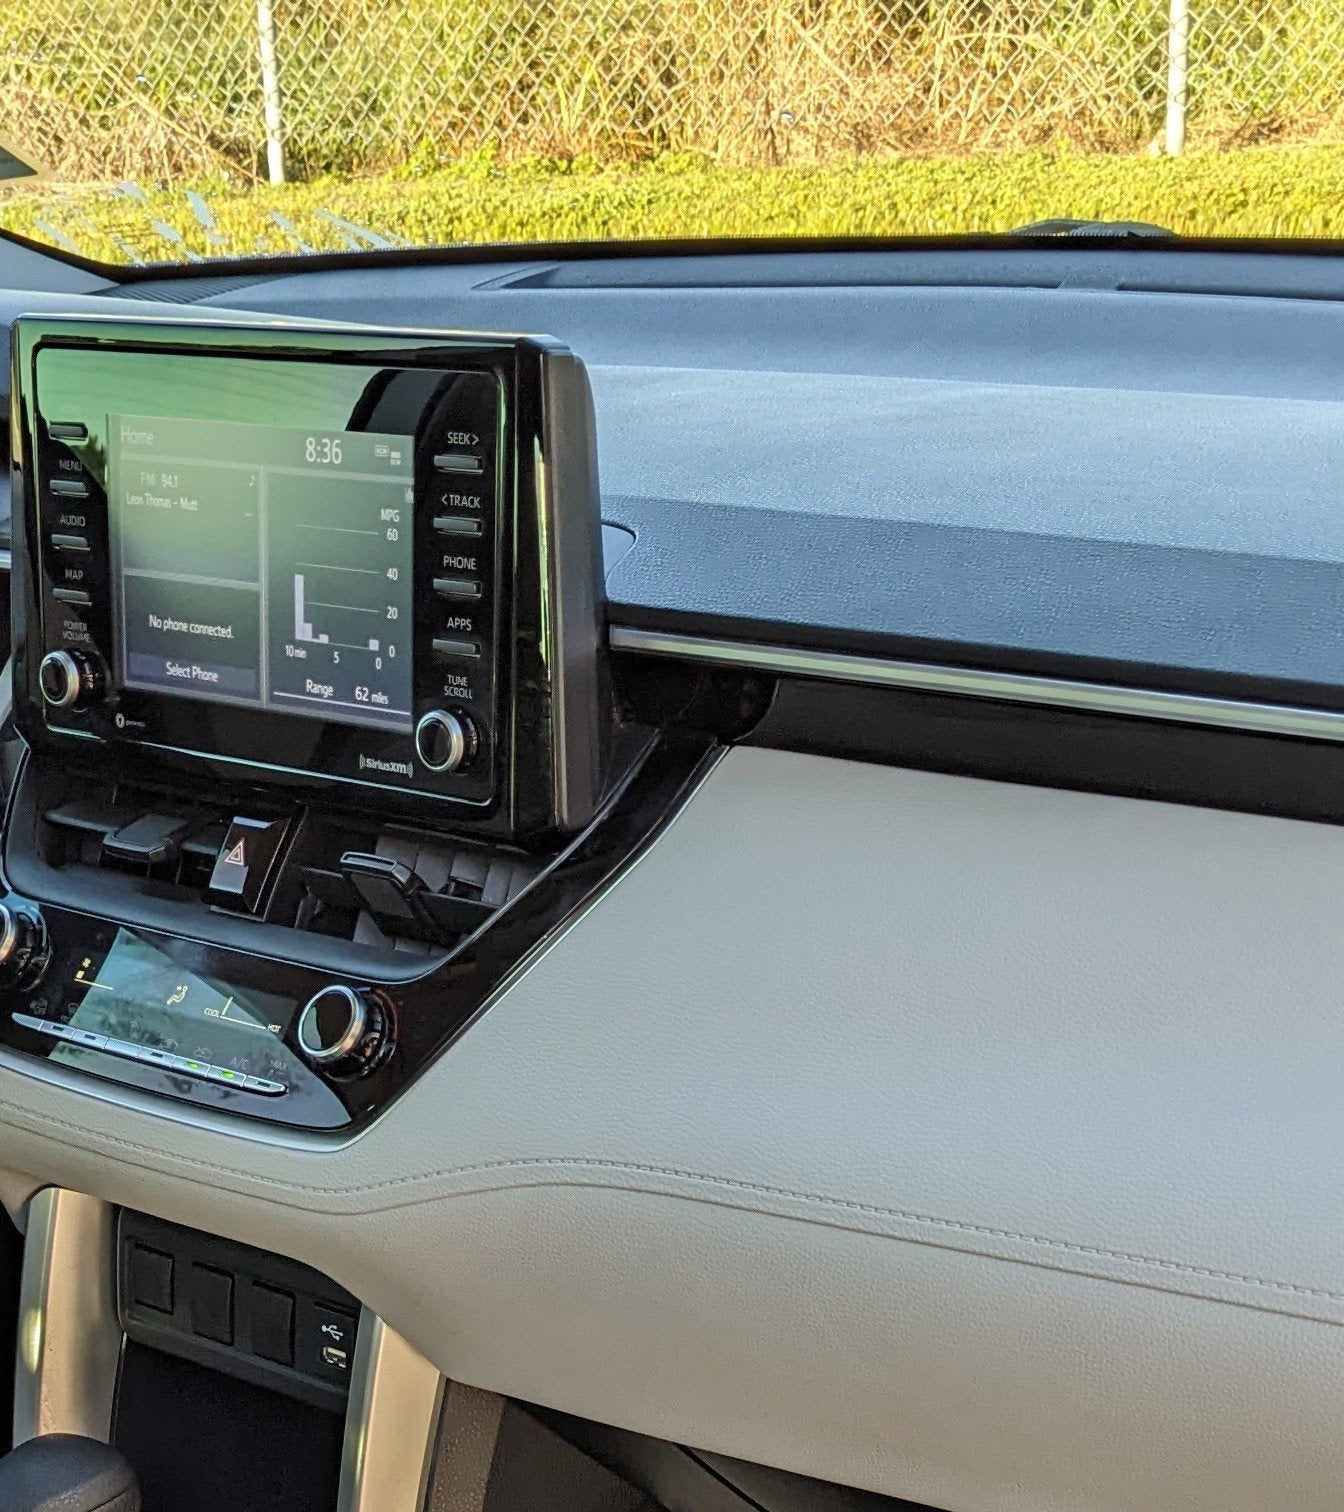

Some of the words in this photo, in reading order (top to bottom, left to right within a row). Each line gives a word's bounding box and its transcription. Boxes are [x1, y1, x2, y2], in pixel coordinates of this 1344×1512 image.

[447, 432, 471, 445] SEEK
[305, 437, 342, 464] 8:36
[449, 494, 481, 509] TRACK
[60, 514, 86, 527] AUDIO
[380, 508, 400, 522] MPG
[386, 528, 399, 541] 60
[443, 555, 477, 571] PHONE
[65, 569, 84, 580] MAP
[386, 568, 399, 581] 40
[386, 606, 399, 620] 20
[148, 614, 162, 629] No
[164, 618, 189, 632] phone
[189, 623, 235, 639] connected.
[447, 617, 472, 631] APPS
[166, 661, 191, 679] Select
[192, 665, 218, 682] Phone
[306, 678, 334, 698] Range
[355, 686, 369, 702] 62
[371, 691, 389, 704] miles
[444, 686, 473, 700] SCROLL
